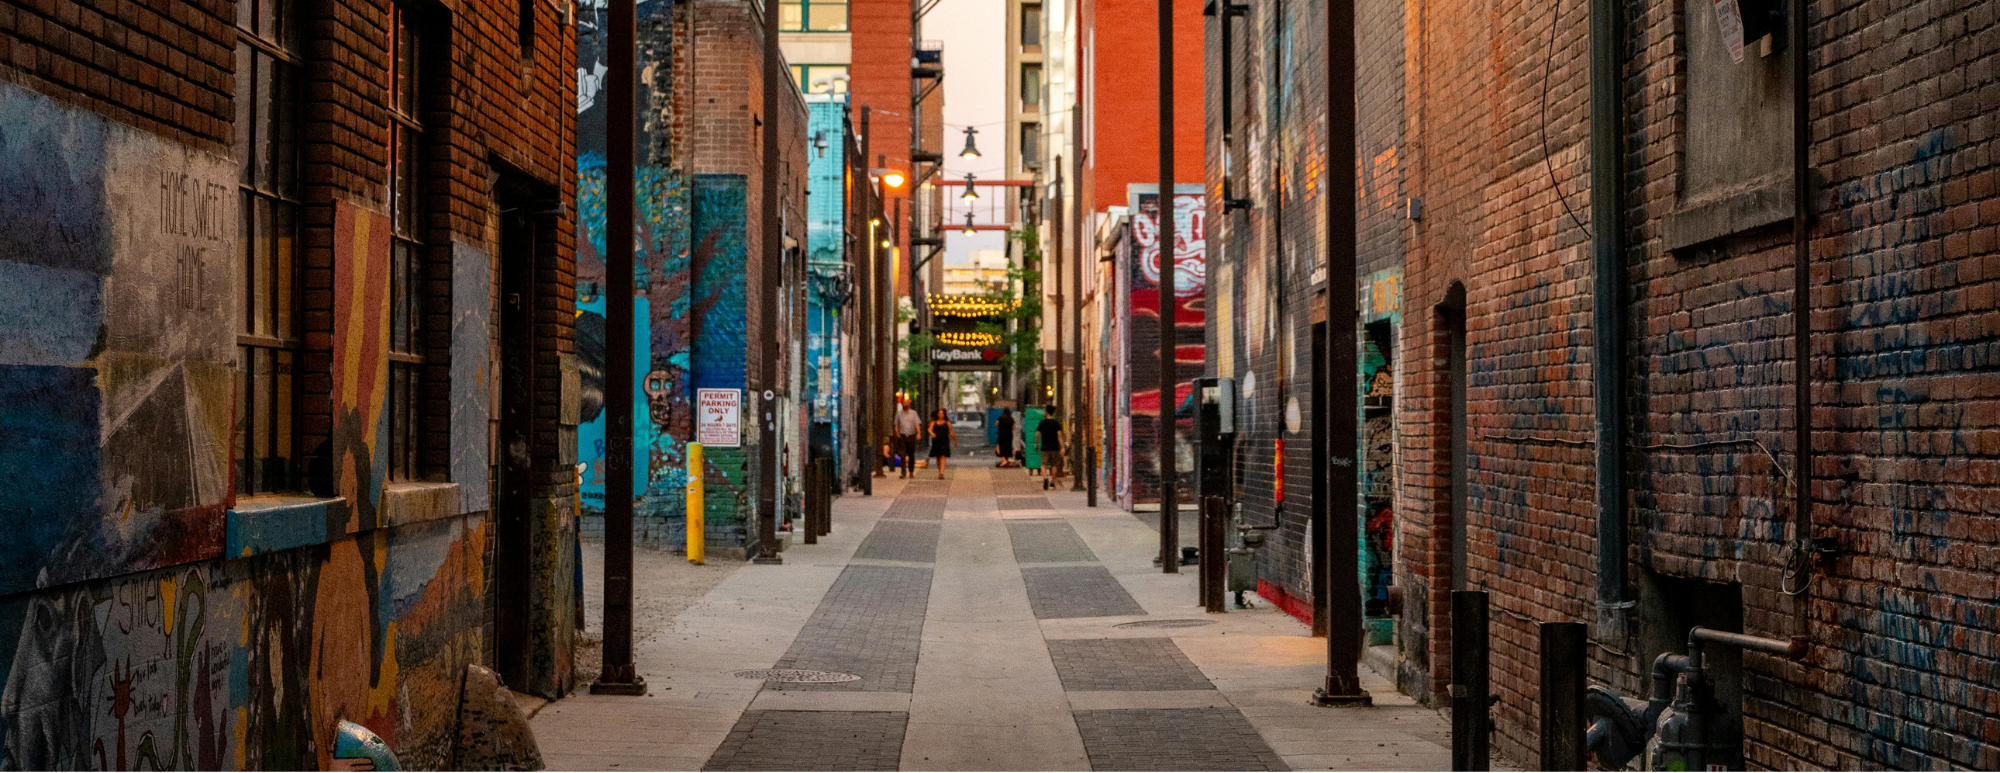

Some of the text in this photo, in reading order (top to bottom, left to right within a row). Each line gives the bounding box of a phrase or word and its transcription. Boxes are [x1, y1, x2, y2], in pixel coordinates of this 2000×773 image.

[160, 170, 226, 243] HOME SWEET
[176, 242, 206, 311] HOME
[931, 349, 982, 362] KeyBank
